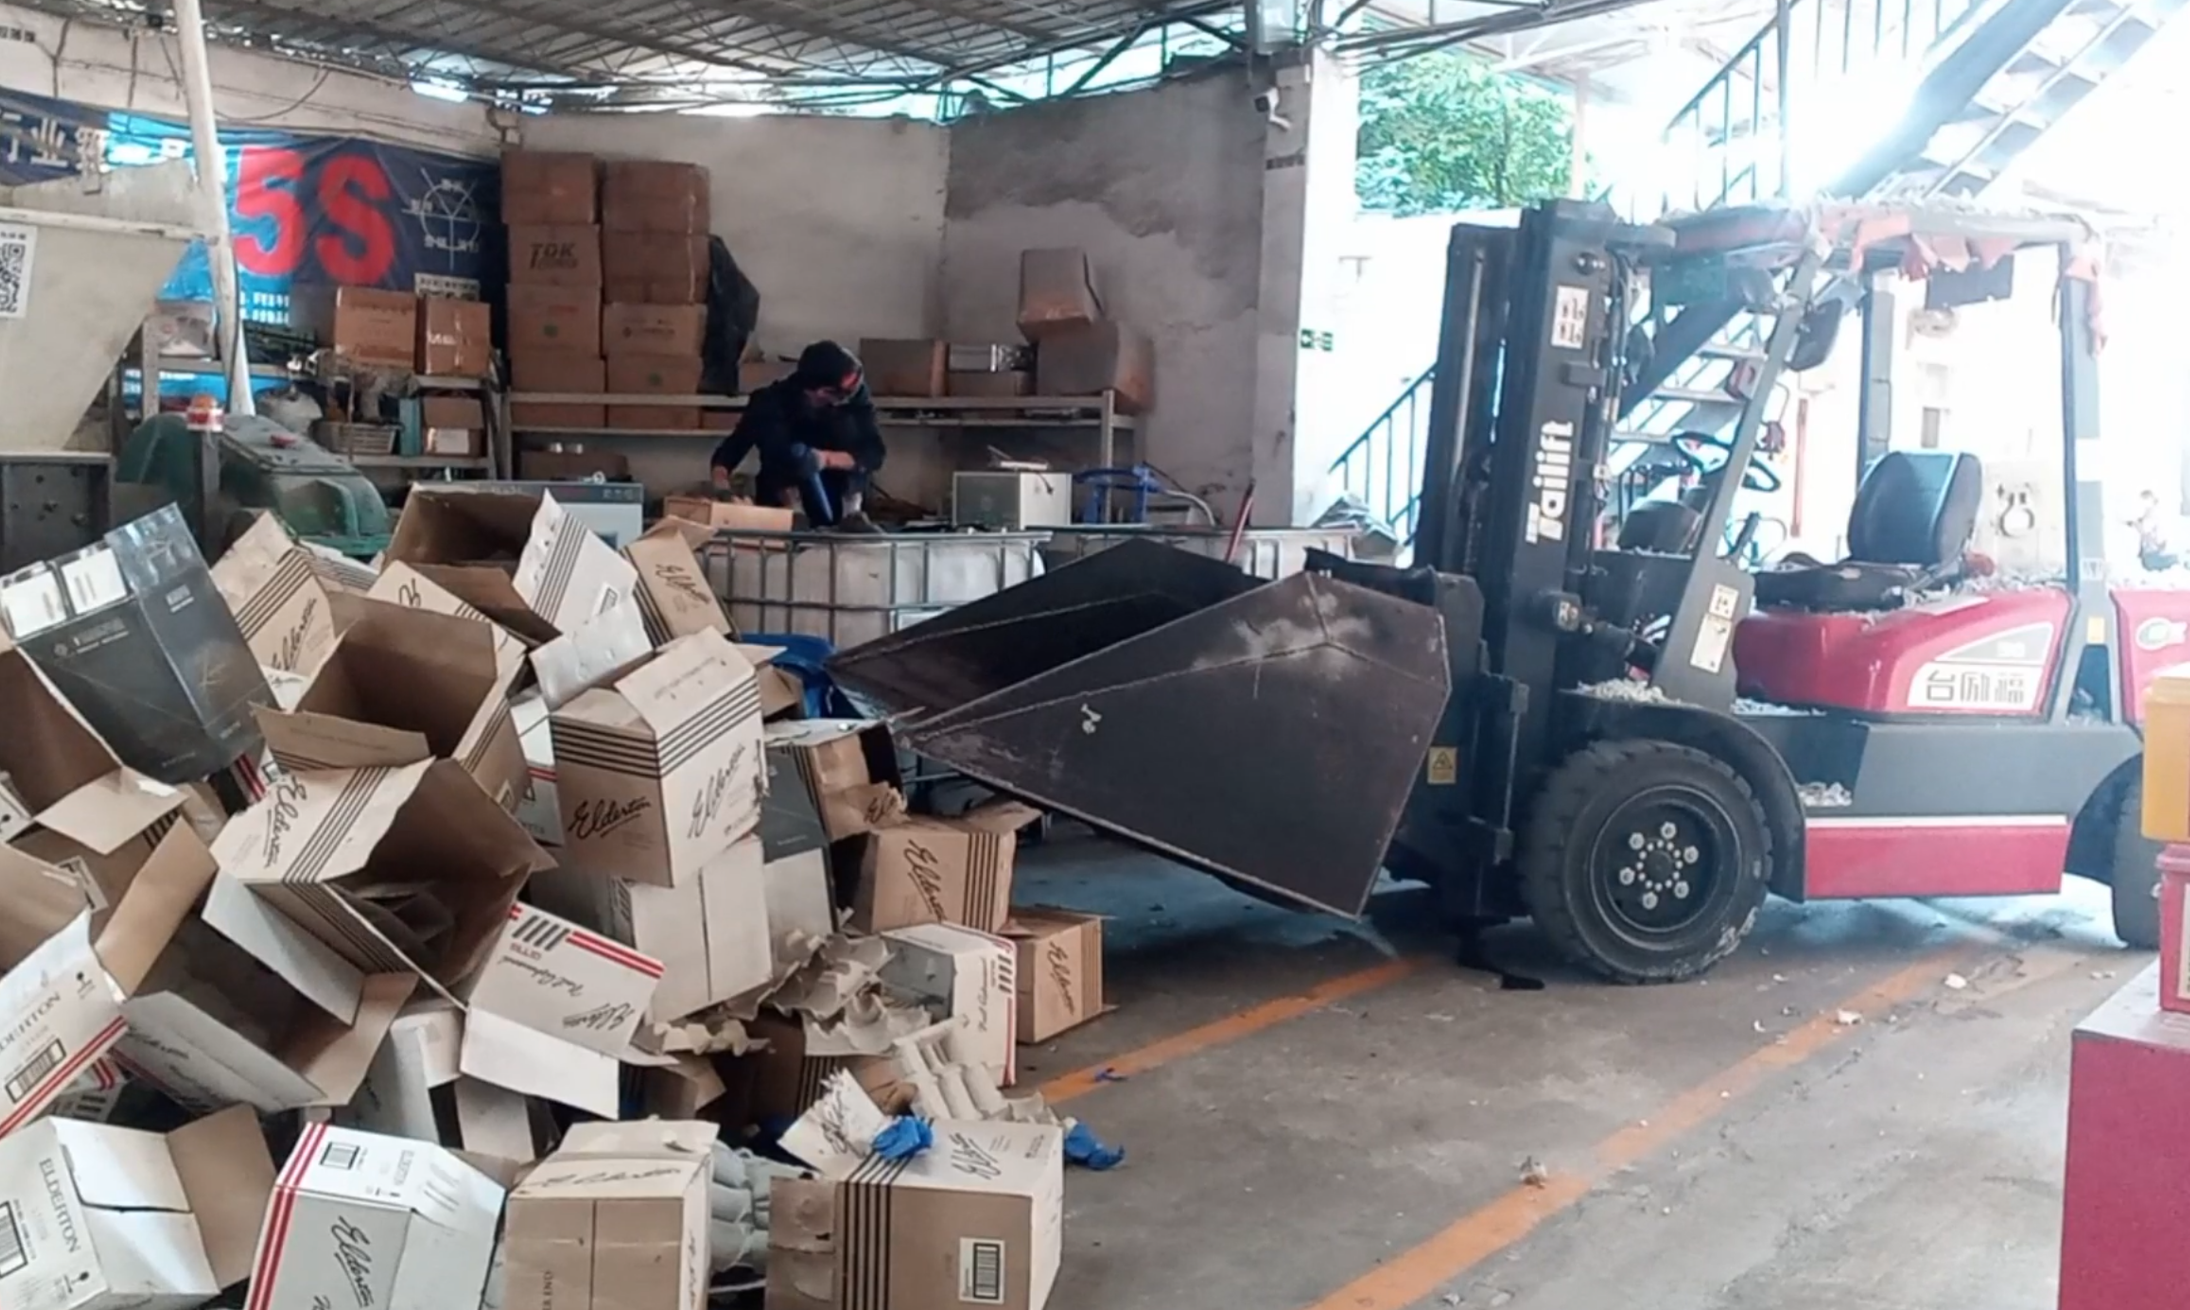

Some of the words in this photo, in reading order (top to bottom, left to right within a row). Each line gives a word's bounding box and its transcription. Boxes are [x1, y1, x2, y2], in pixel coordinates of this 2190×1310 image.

[234, 145, 395, 284] 5S
[1525, 420, 1574, 544] Tailift
[1927, 669, 2026, 704] 台励福
[568, 796, 652, 839] Elderton
[39, 1157, 82, 1254] ELDERTON
[330, 1215, 376, 1308] Elderton
